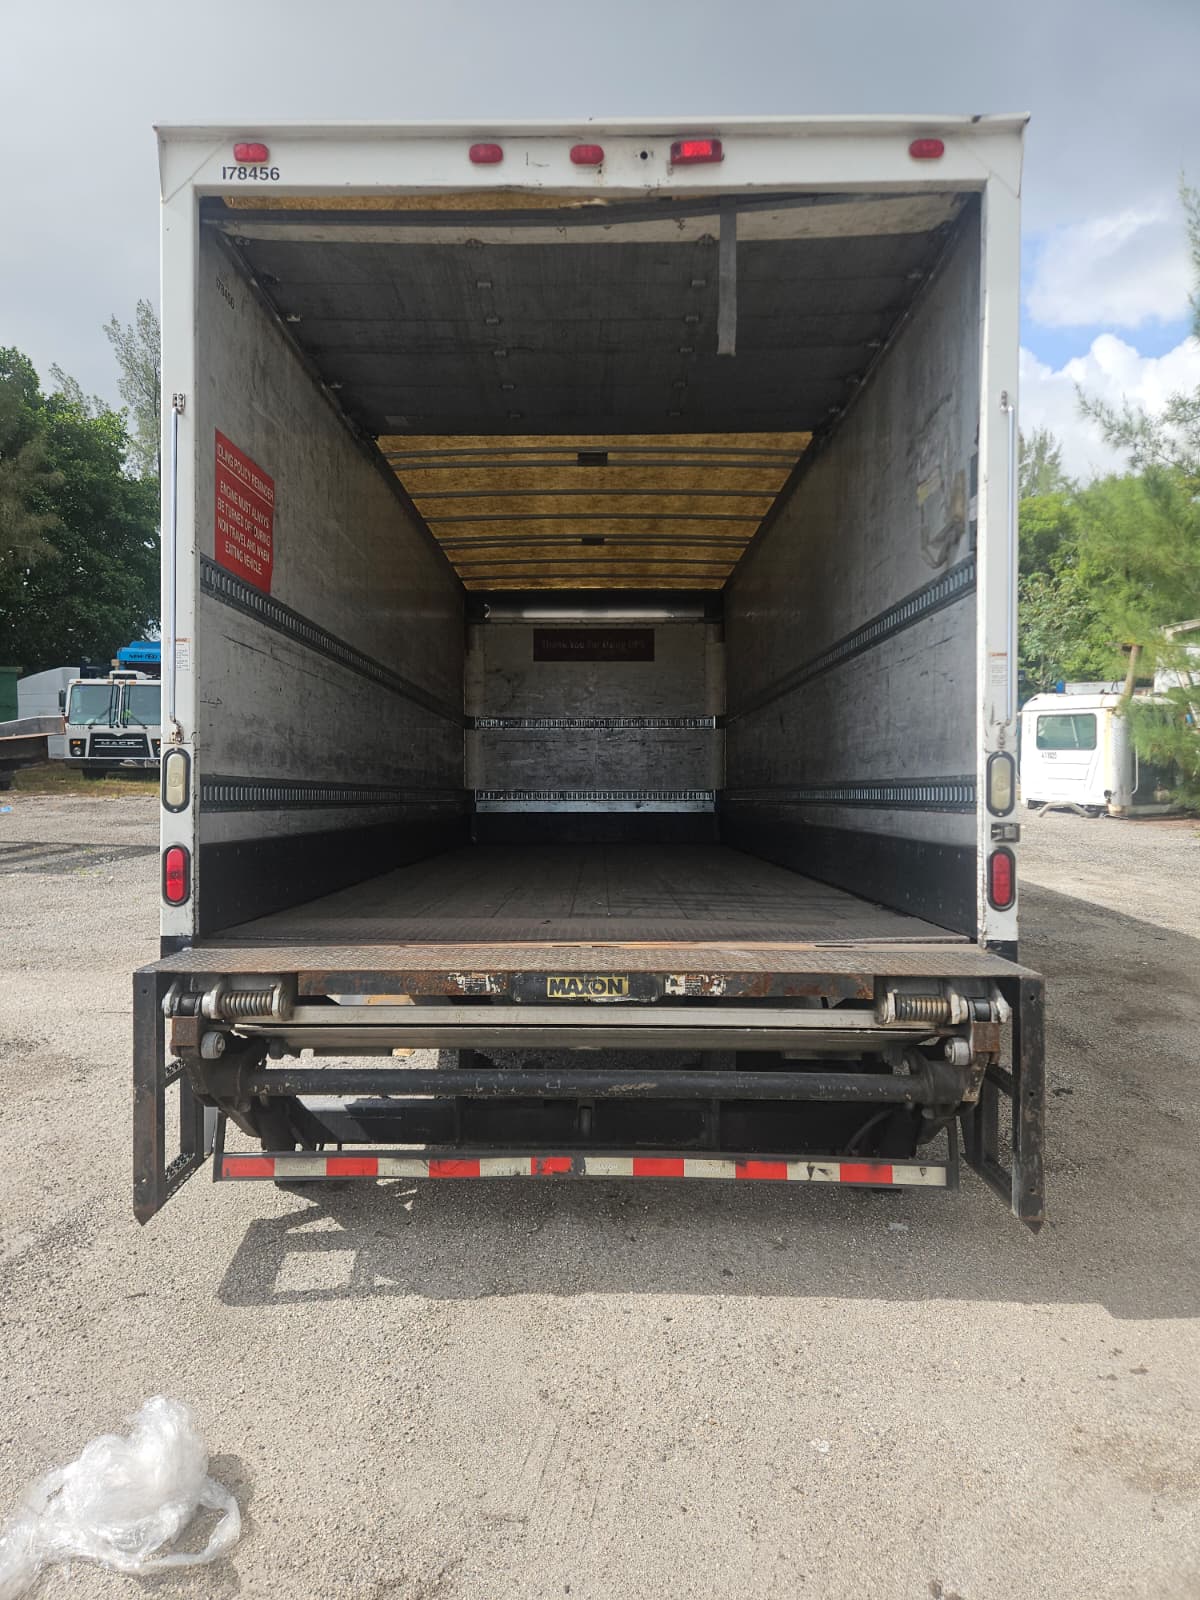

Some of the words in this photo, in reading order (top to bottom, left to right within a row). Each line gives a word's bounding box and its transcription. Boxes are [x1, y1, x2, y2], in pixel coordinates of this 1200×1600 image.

[233, 457, 252, 482] POLICY
[251, 473, 274, 502] REMINDER
[217, 497, 225, 513] BE
[225, 503, 244, 528] TURNED
[244, 518, 254, 532] OFF
[253, 526, 271, 547] DURING
[220, 480, 238, 504] ENGINE
[238, 495, 252, 516] MUST
[251, 506, 269, 529] ALWAYS
[217, 516, 229, 536] NON
[229, 525, 247, 547] TRAVEL
[246, 538, 256, 554] AND
[256, 545, 270, 565] WHEN
[225, 540, 244, 563] EXITING
[549, 978, 623, 995] MAXON
